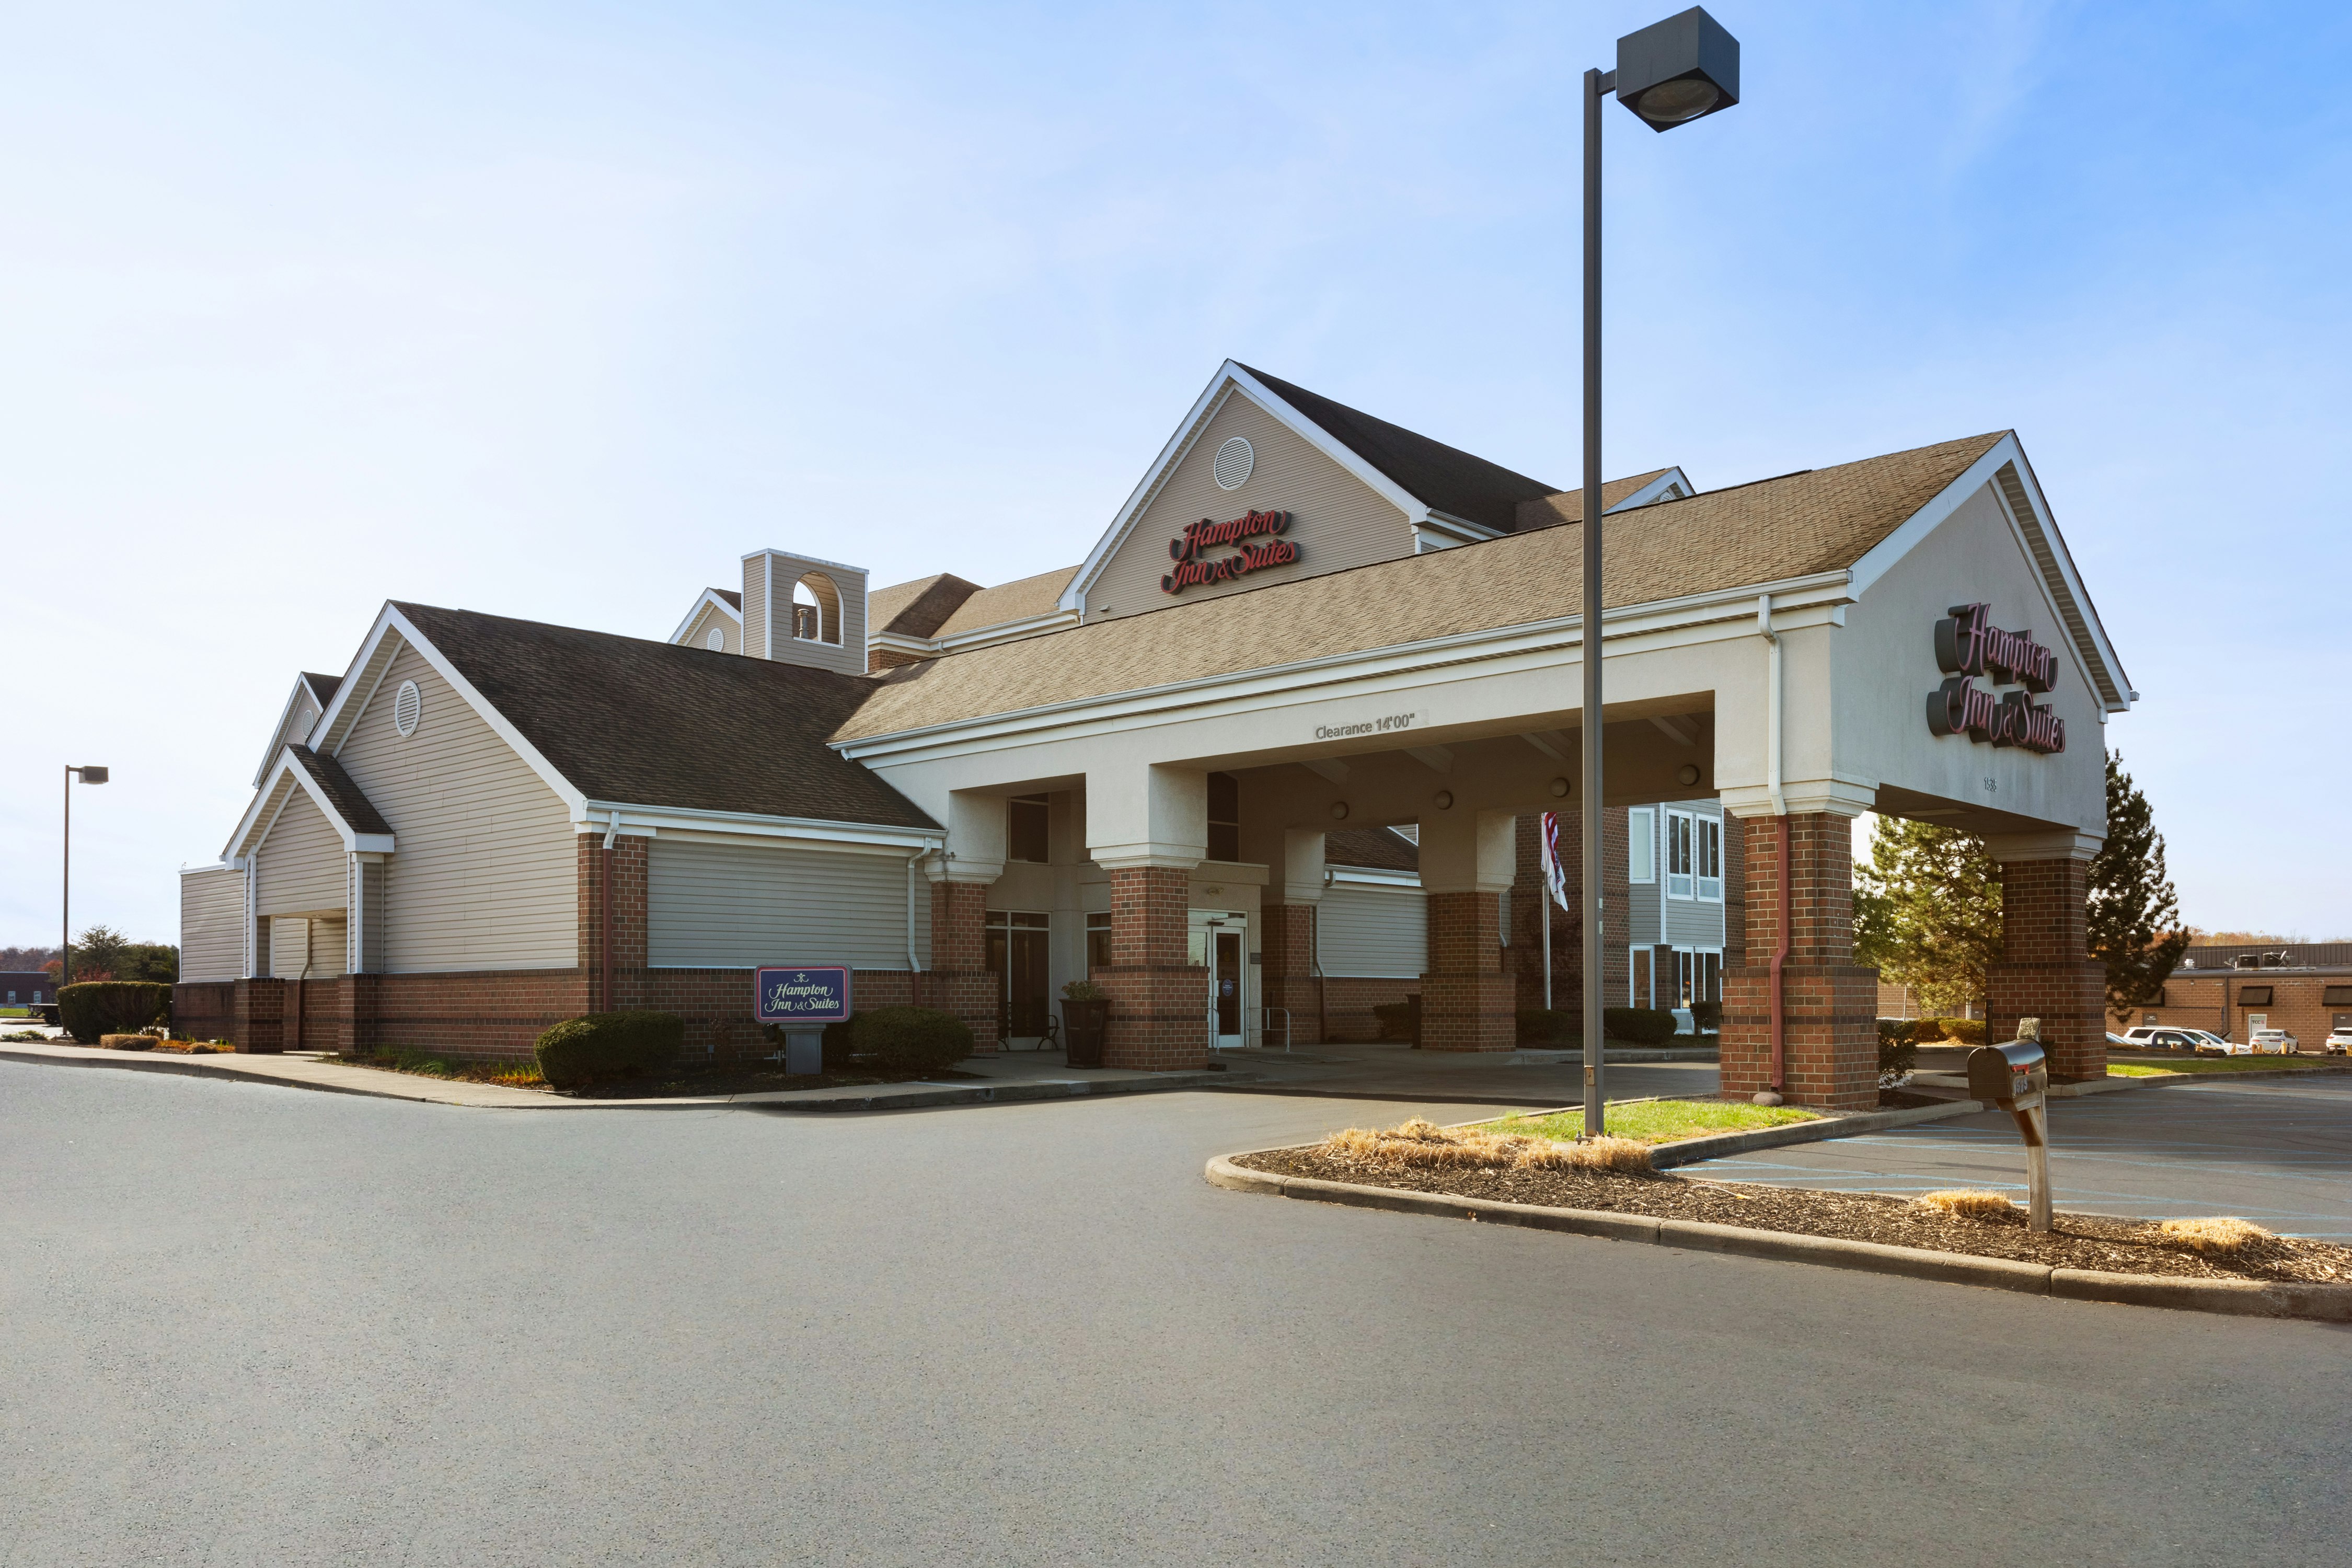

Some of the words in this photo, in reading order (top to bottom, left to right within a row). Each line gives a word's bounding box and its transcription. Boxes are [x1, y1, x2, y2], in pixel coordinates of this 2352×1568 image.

[1169, 510, 1288, 562] Hampton
[1160, 560, 1219, 594] Inn
[1217, 558, 1236, 580] &
[1231, 539, 1297, 574] Suites
[1953, 602, 2058, 693] Hampton
[1315, 722, 1373, 740] Clearance
[1376, 713, 1415, 731] 14'00"
[1944, 675, 2003, 742] Inn
[2003, 702, 2017, 746] &
[2014, 690, 2066, 753] Suites
[764, 998, 798, 1012] Inn
[797, 1001, 806, 1011] &
[804, 997, 840, 1010] Suites
[768, 983, 833, 999] Hampton
